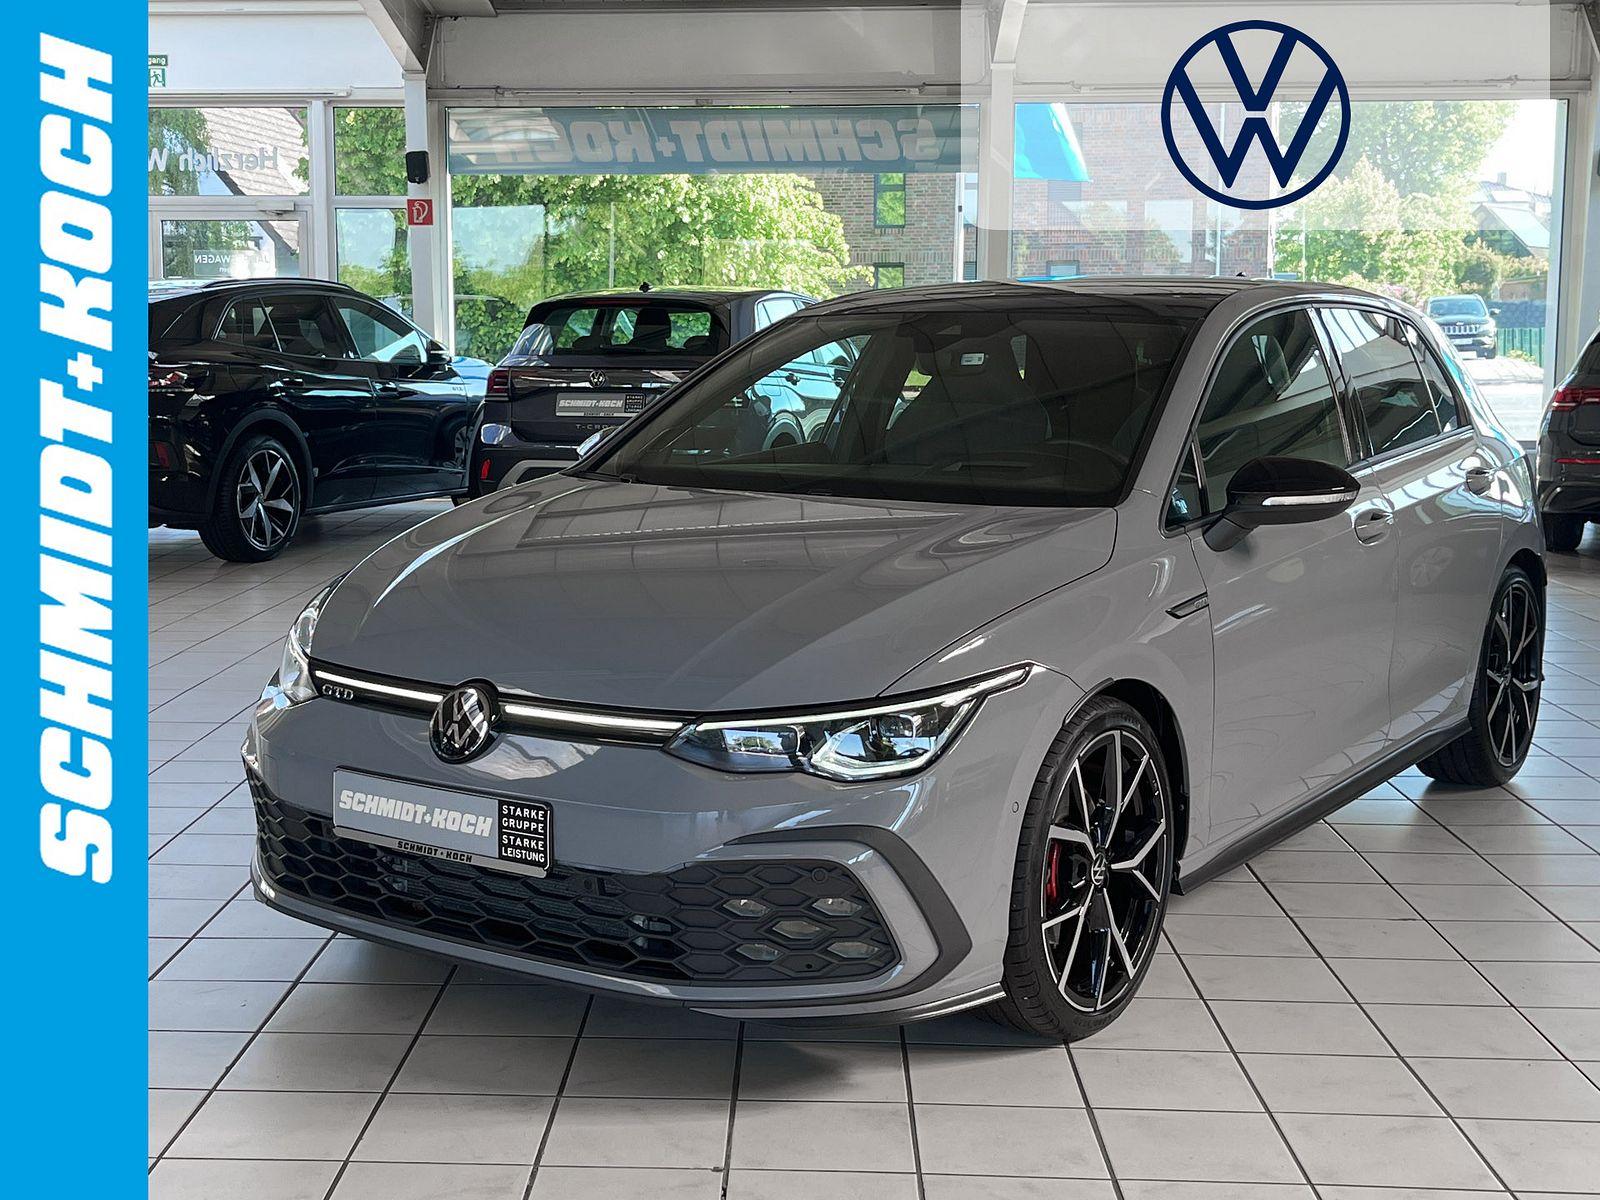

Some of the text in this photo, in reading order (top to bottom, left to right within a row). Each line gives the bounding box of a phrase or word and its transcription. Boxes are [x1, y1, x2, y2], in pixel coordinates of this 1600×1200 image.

[321, 683, 354, 701] GTD
[338, 789, 493, 838] SCHMIDT+KOCH
[502, 804, 545, 821] STARKE
[502, 817, 545, 833] GRUPPE
[502, 835, 545, 851] STARKE
[502, 846, 545, 863] LEISTUNG
